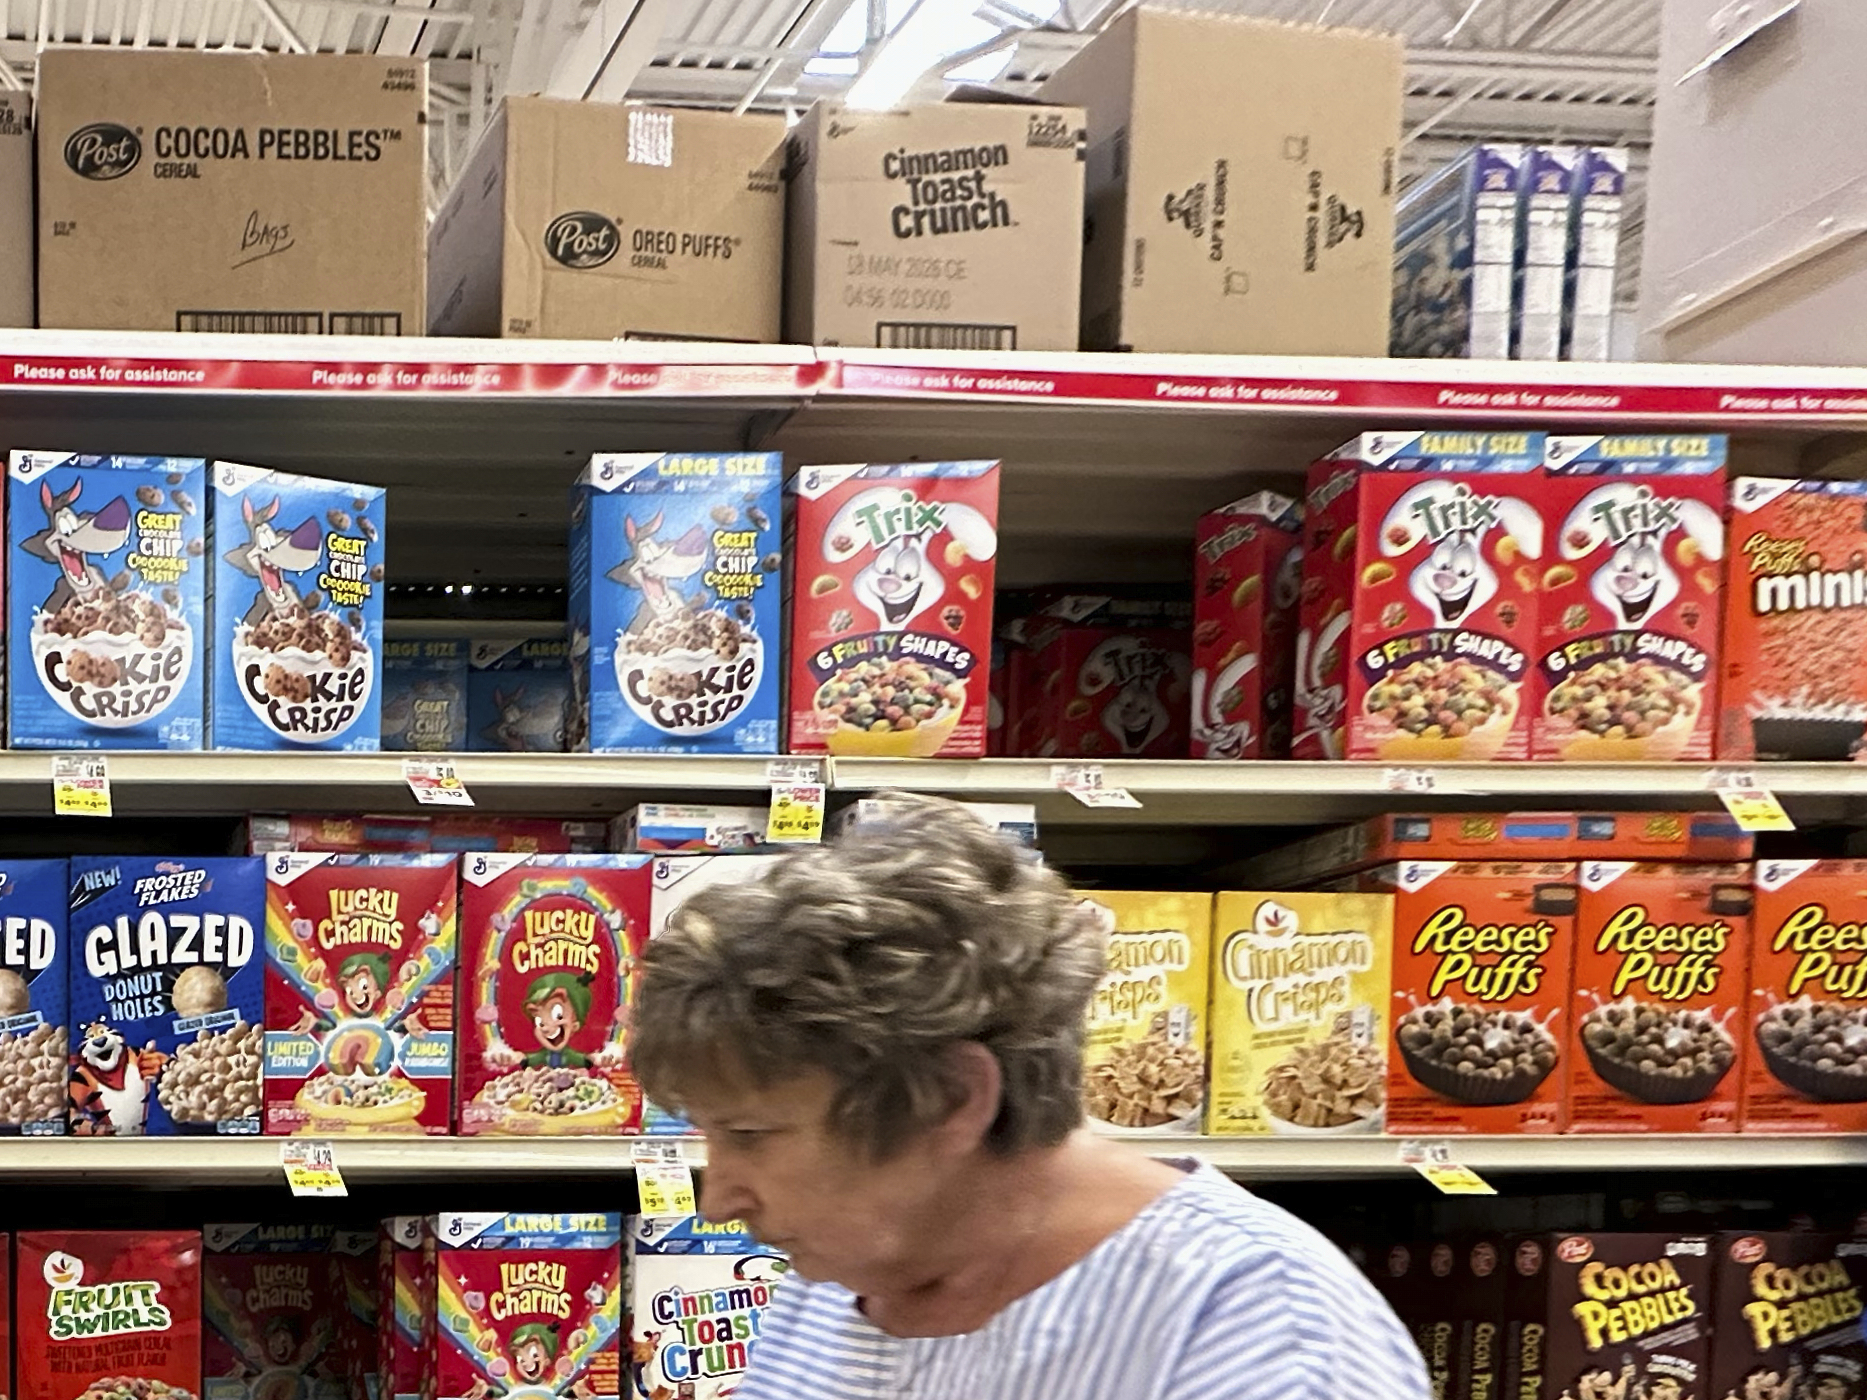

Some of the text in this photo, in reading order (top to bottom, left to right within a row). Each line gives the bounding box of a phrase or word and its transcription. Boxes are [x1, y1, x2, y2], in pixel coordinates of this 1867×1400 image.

[154, 128, 250, 159] COCOA
[153, 162, 201, 179] CEREAL
[883, 144, 1009, 180] Cinnamon
[905, 172, 988, 207] Toast
[891, 195, 1010, 239] Crunch
[553, 220, 612, 257] Post
[633, 229, 732, 259] OREO PUFFS
[14, 364, 205, 382] Please ask for assistance
[609, 370, 658, 387] Please
[1156, 383, 1339, 403] Please ask for assistance
[1720, 394, 1822, 413] Please ask for
[1420, 432, 1529, 456] FAMILY SIZE
[1599, 436, 1708, 457] FAMILY SIZE
[136, 510, 183, 532] GREAT
[855, 492, 946, 544] Trix
[1593, 486, 1681, 540] Trix
[327, 534, 367, 556] GREAT
[330, 559, 368, 581] CHIP
[716, 555, 758, 574] CHIP
[715, 585, 754, 599] TASTE!
[1367, 650, 1383, 669] 6
[1453, 632, 1524, 671] SHAPES
[83, 866, 122, 892] NEW!
[1598, 904, 1728, 955] Reese's
[85, 912, 253, 980] GLAZED
[511, 935, 600, 978] Charms
[1227, 928, 1371, 984] Cinnamon
[1431, 951, 1544, 1000] Puffs
[1615, 949, 1720, 998] Puffs
[110, 993, 165, 1023] HOLES
[1250, 975, 1345, 1027] Crisps
[266, 1041, 316, 1056] LIMITED
[406, 1043, 449, 1056] JUMBO
[504, 1215, 607, 1232] LARGE SIZE
[692, 1218, 747, 1234] LARGE
[1579, 1258, 1680, 1299] COCOA
[1751, 1258, 1850, 1300] COCOA
[48, 1283, 159, 1316] FRUIT
[50, 1307, 171, 1338] SWIRLS
[1472, 1323, 1494, 1370] COCOA
